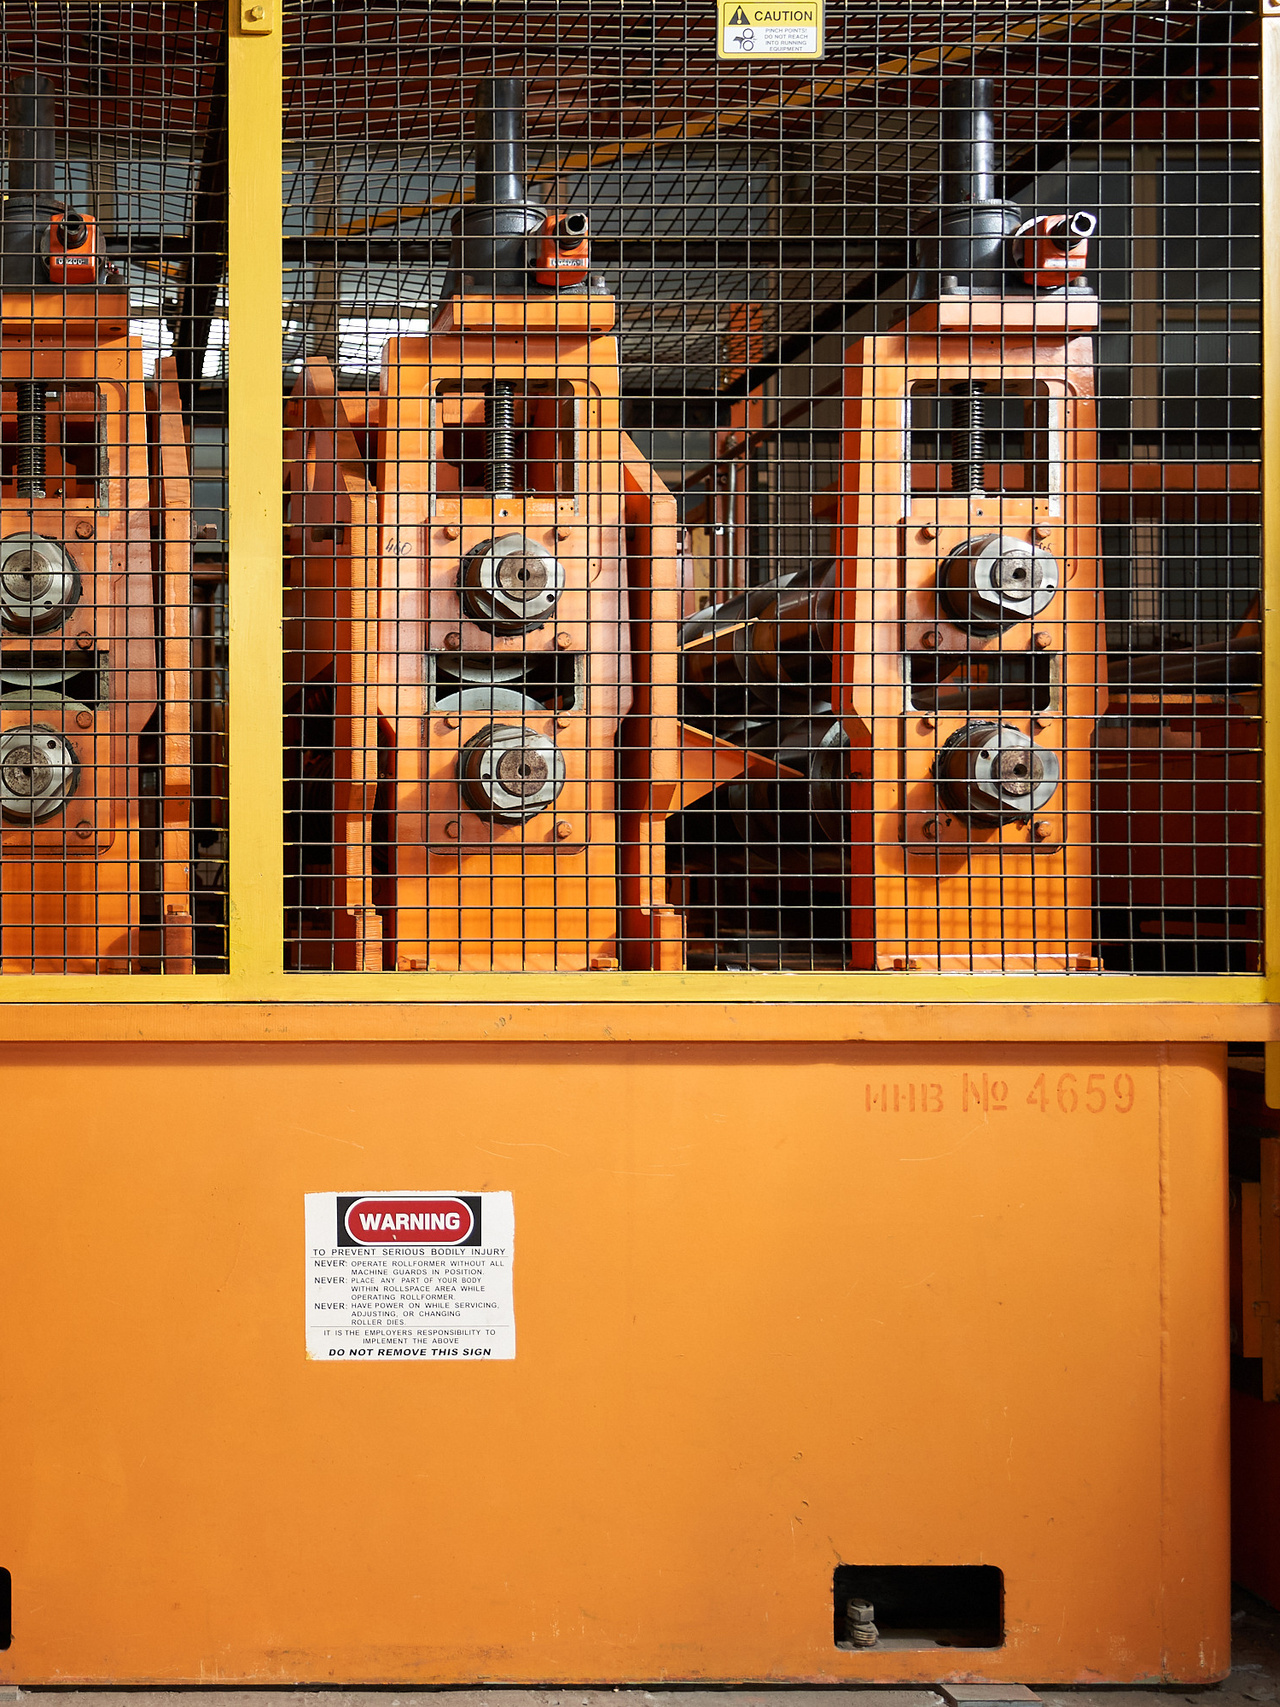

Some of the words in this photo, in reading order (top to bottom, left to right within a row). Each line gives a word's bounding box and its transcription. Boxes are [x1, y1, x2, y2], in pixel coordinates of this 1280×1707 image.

[754, 11, 813, 21] CAUTION
[1026, 1073, 1135, 1113] 4659
[359, 1212, 460, 1231] WARNING
